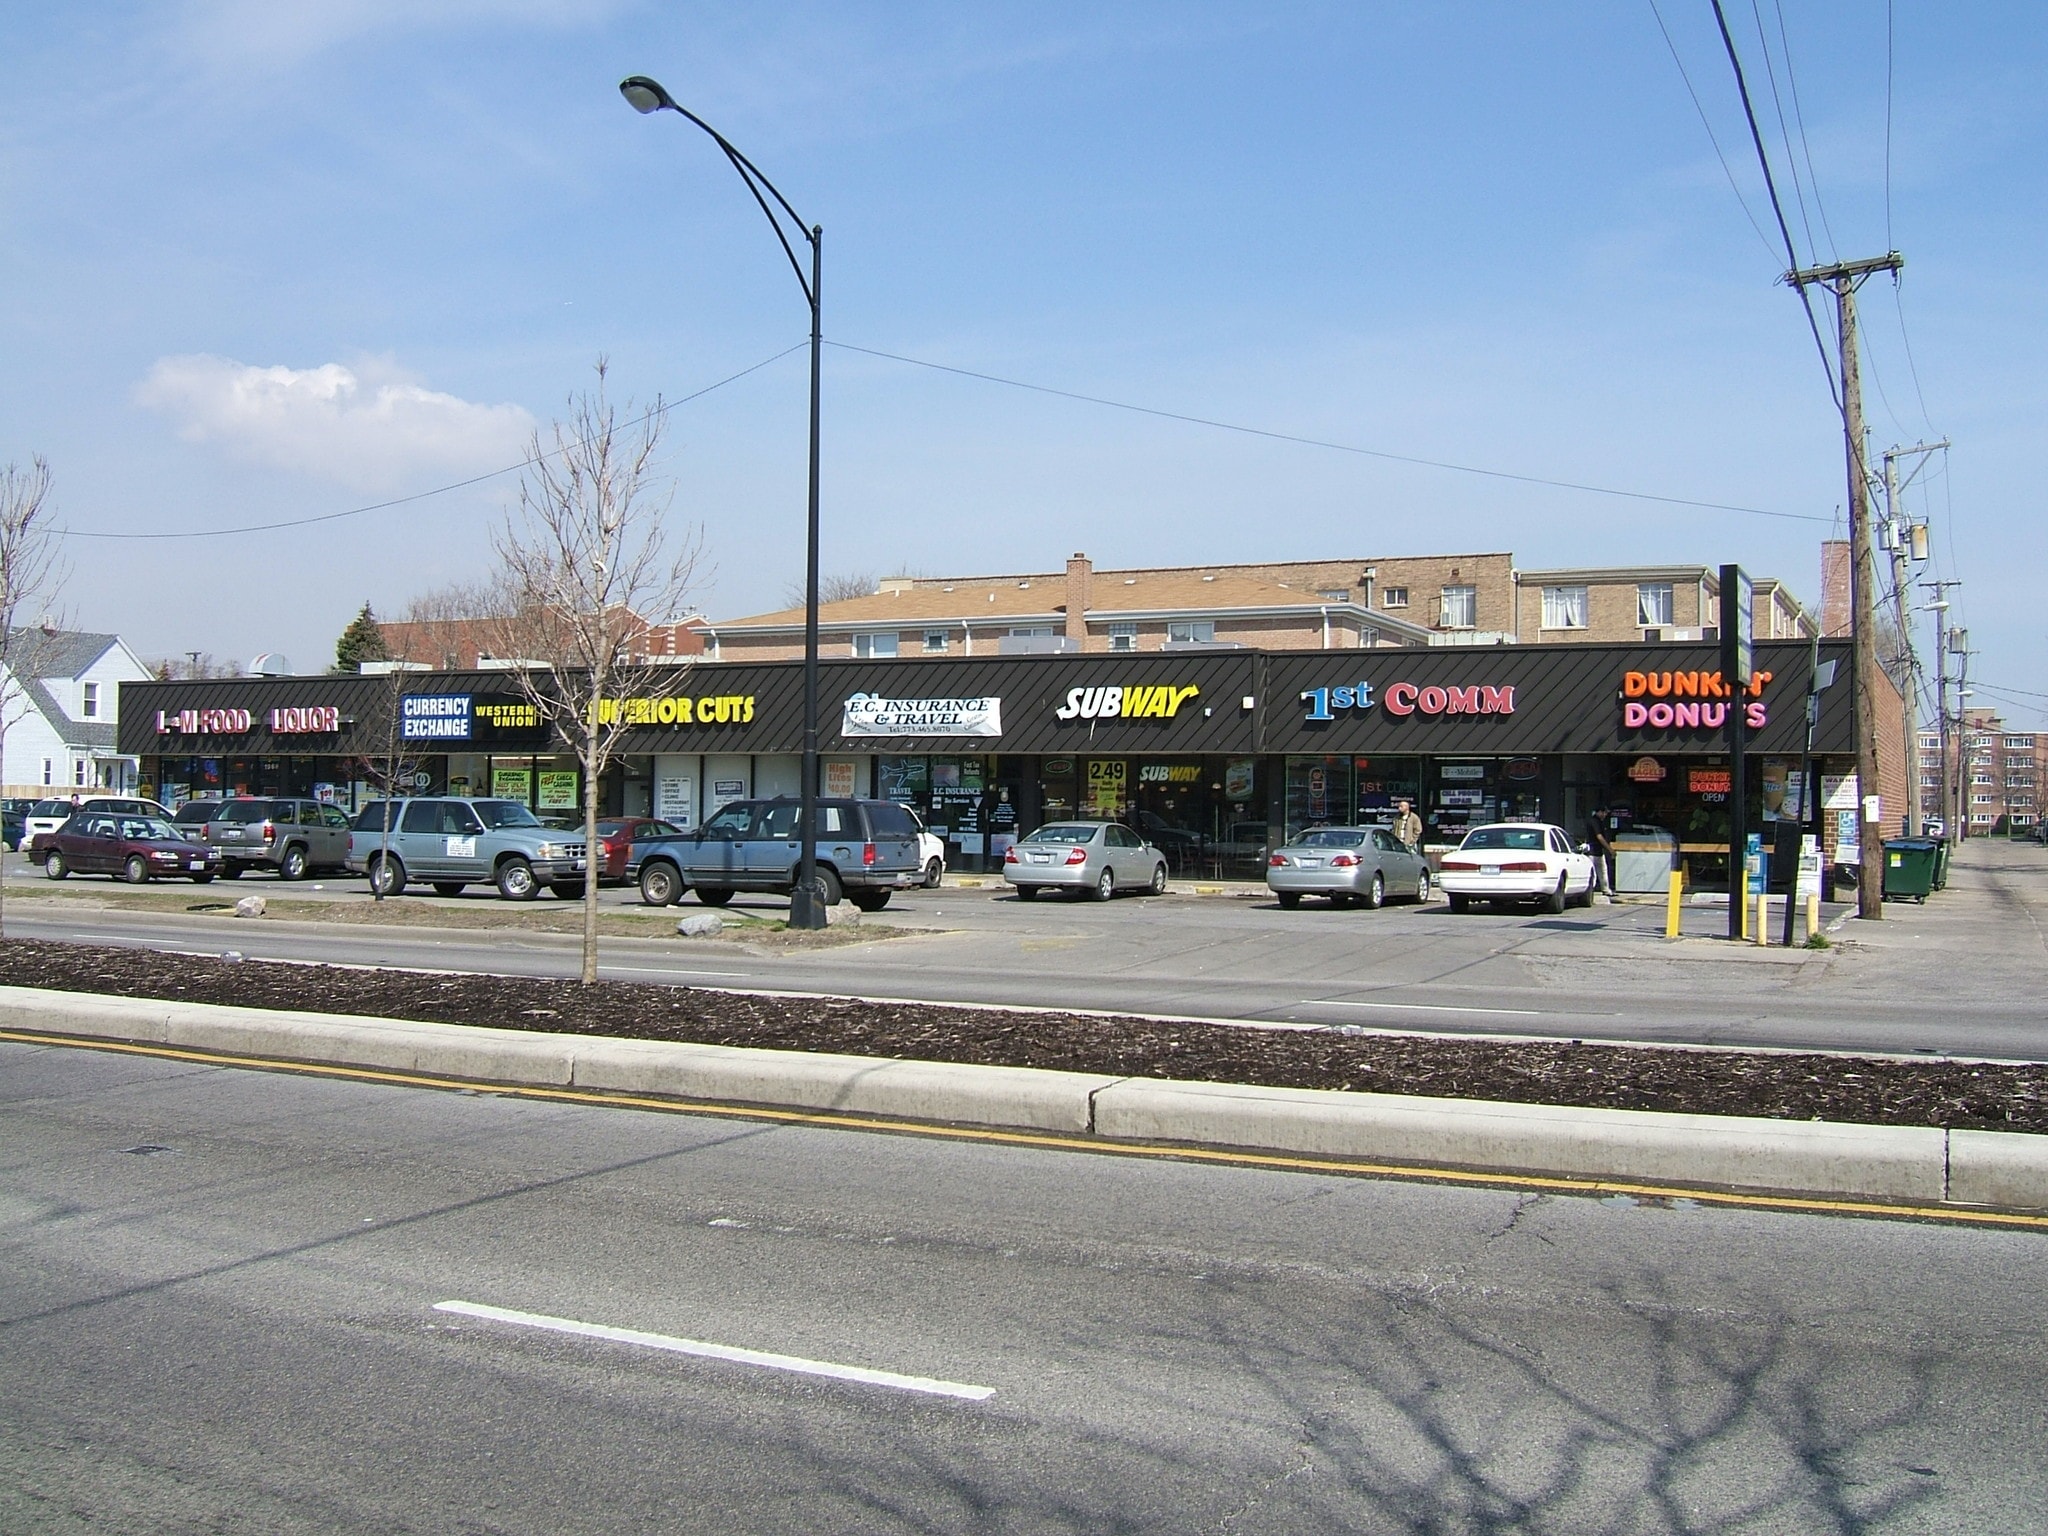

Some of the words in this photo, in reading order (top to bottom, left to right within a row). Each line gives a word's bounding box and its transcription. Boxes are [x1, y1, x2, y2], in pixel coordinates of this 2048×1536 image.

[404, 697, 470, 716] CURRENCY
[849, 701, 879, 712] E.C.
[884, 700, 989, 712] INSURANCE
[1056, 684, 1199, 720] SUBWAY
[1301, 681, 1374, 719] 1st
[1385, 683, 1516, 715] COMM
[475, 705, 535, 717] WESTERN
[697, 696, 755, 724] CUTS
[1625, 702, 1767, 728] DONUS
[201, 708, 251, 734] FOOD
[272, 707, 339, 734] LIQUOR
[493, 717, 535, 728] UNION
[874, 713, 890, 725] &
[894, 713, 963, 725] TRAVEL
[404, 718, 469, 737] EXCHANGE
[828, 764, 852, 774] High
[1139, 766, 1200, 781] SUBWAY
[889, 787, 912, 795] TRAVEL
[1702, 793, 1725, 802] OPEN
